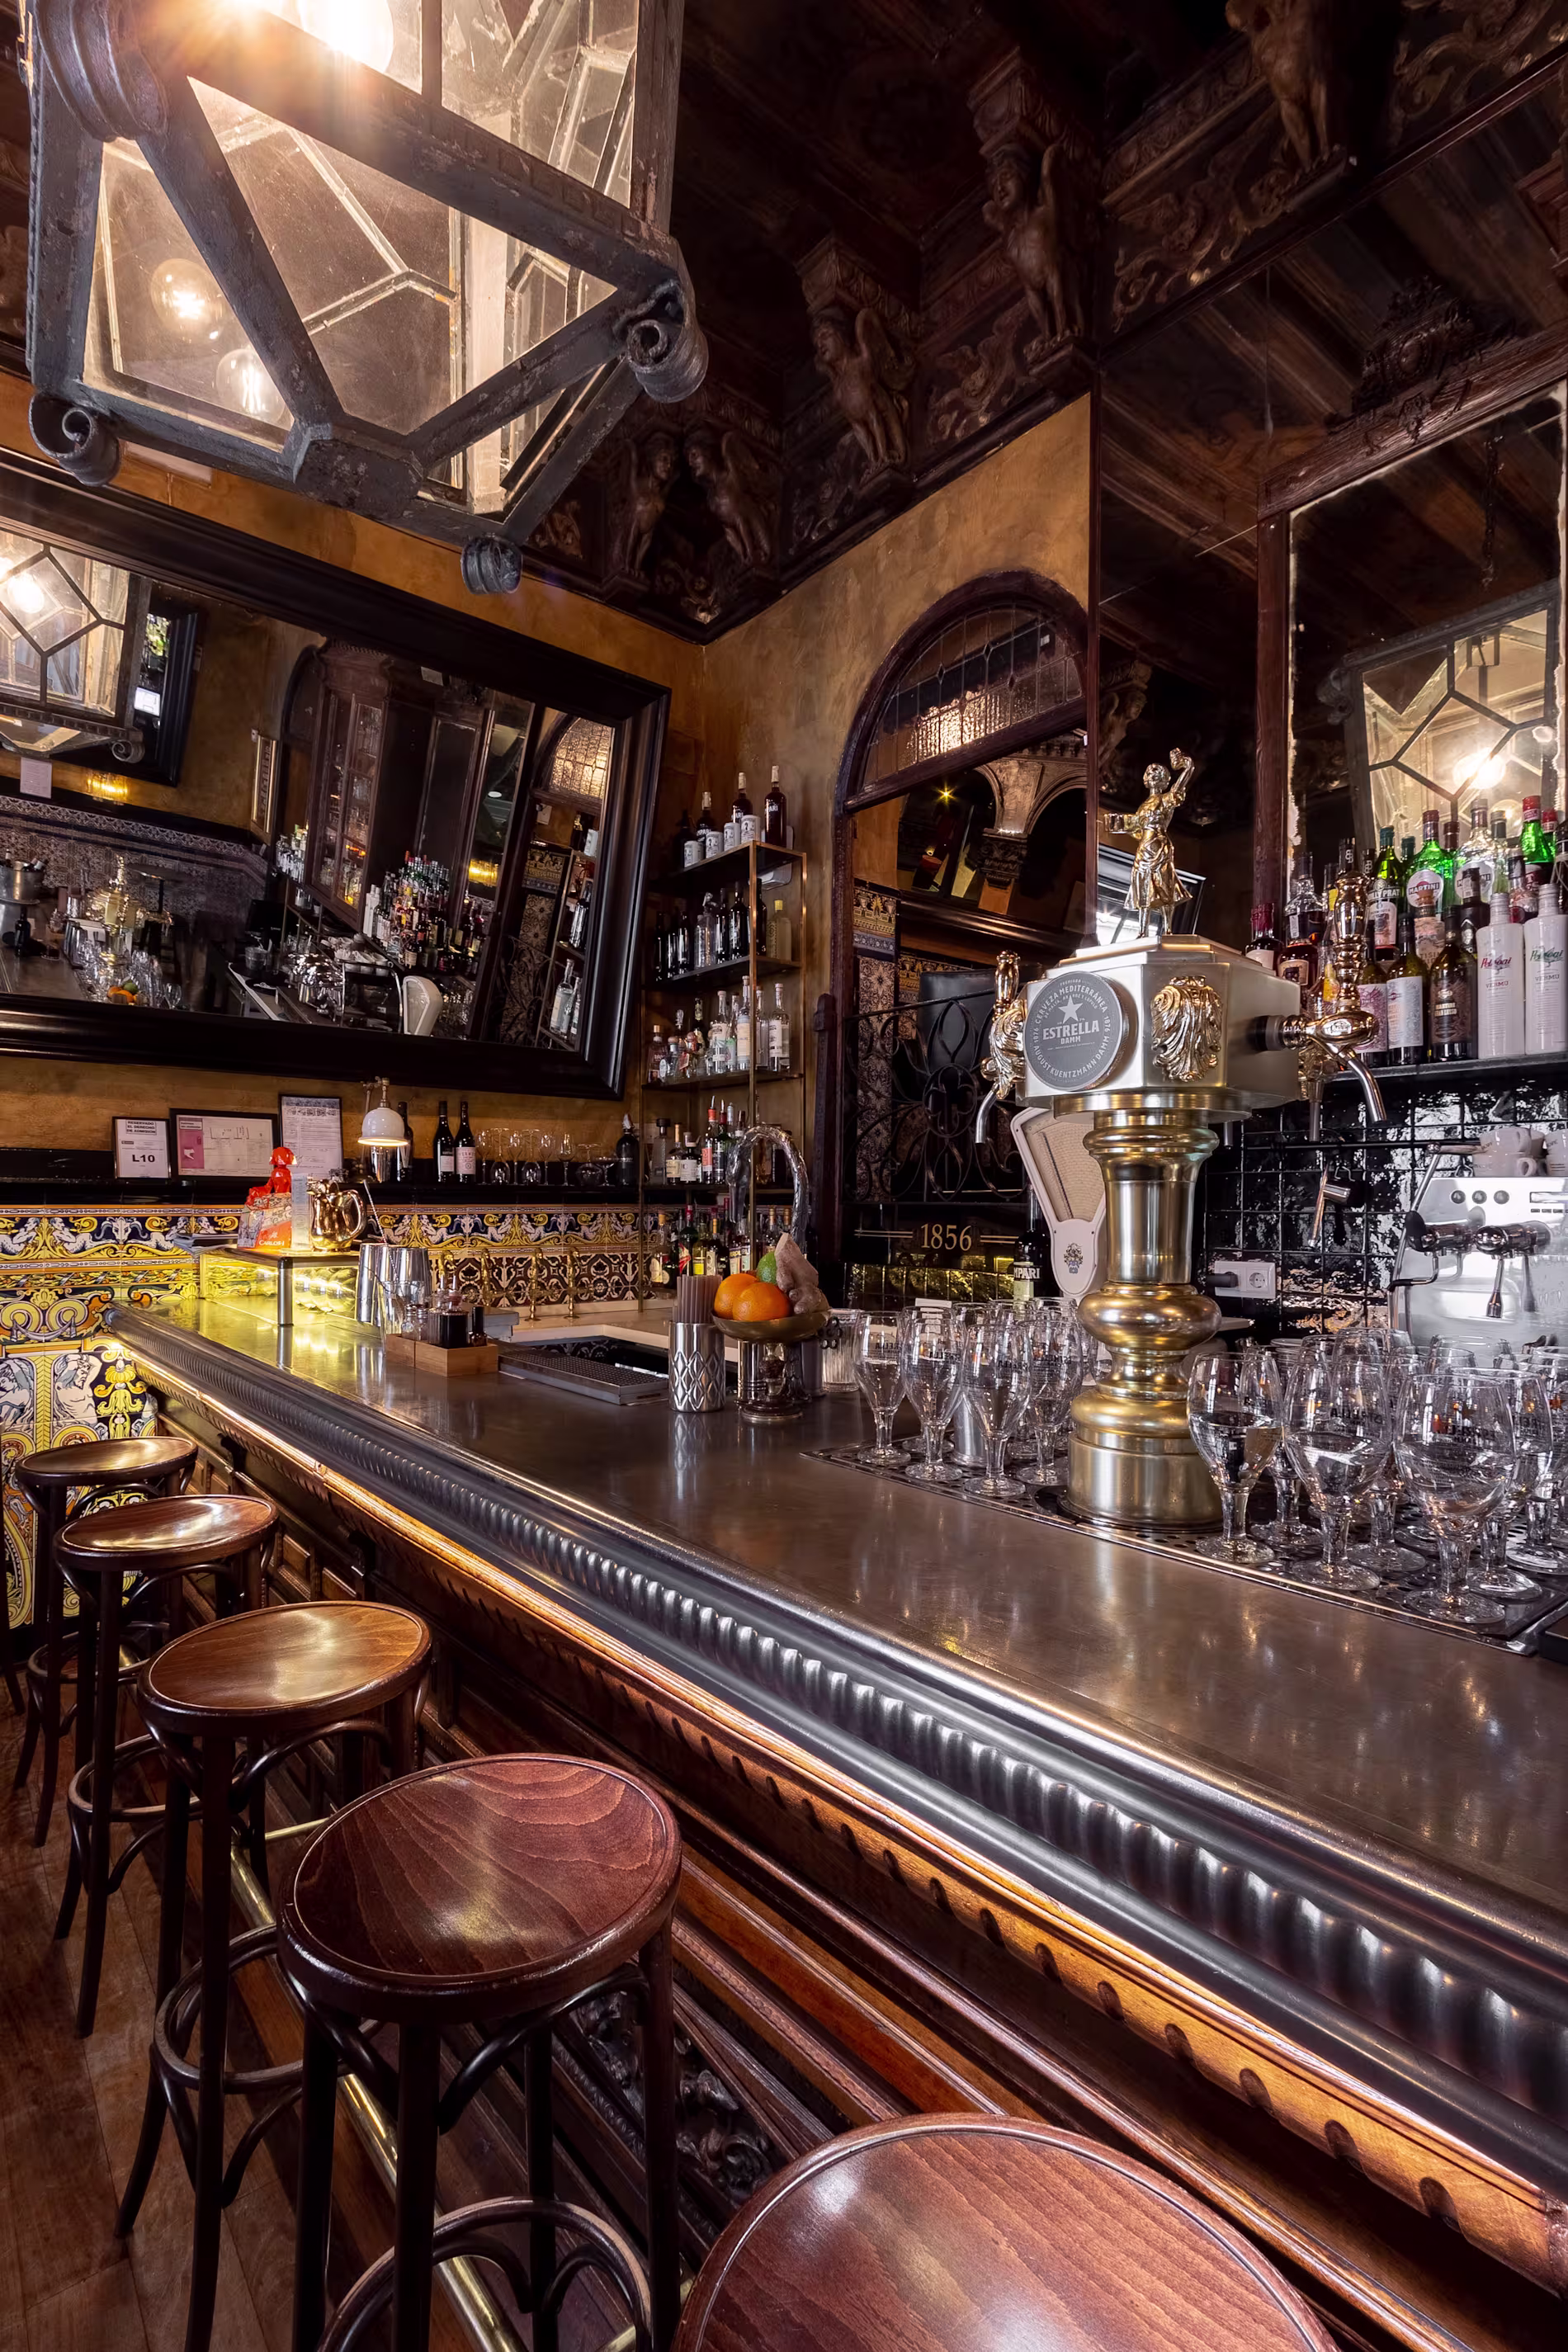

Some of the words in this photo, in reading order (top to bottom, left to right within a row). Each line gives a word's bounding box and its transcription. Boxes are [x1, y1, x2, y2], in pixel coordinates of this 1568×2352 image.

[1382, 889, 1400, 898] PRAT
[1409, 882, 1440, 895] MARTINI
[1035, 992, 1059, 1024] CERVEZA
[1059, 985, 1108, 1013] MEDITERRÁNEA
[1042, 1019, 1100, 1041] ESTRELLA
[1060, 1035, 1081, 1045] DAMM
[1033, 1045, 1052, 1071] AUGUST
[1050, 1058, 1097, 1079] KUENTZMANN
[1096, 1036, 1110, 1060] DAMM
[132, 1154, 155, 1163] L10
[921, 1223, 972, 1251] 1856
